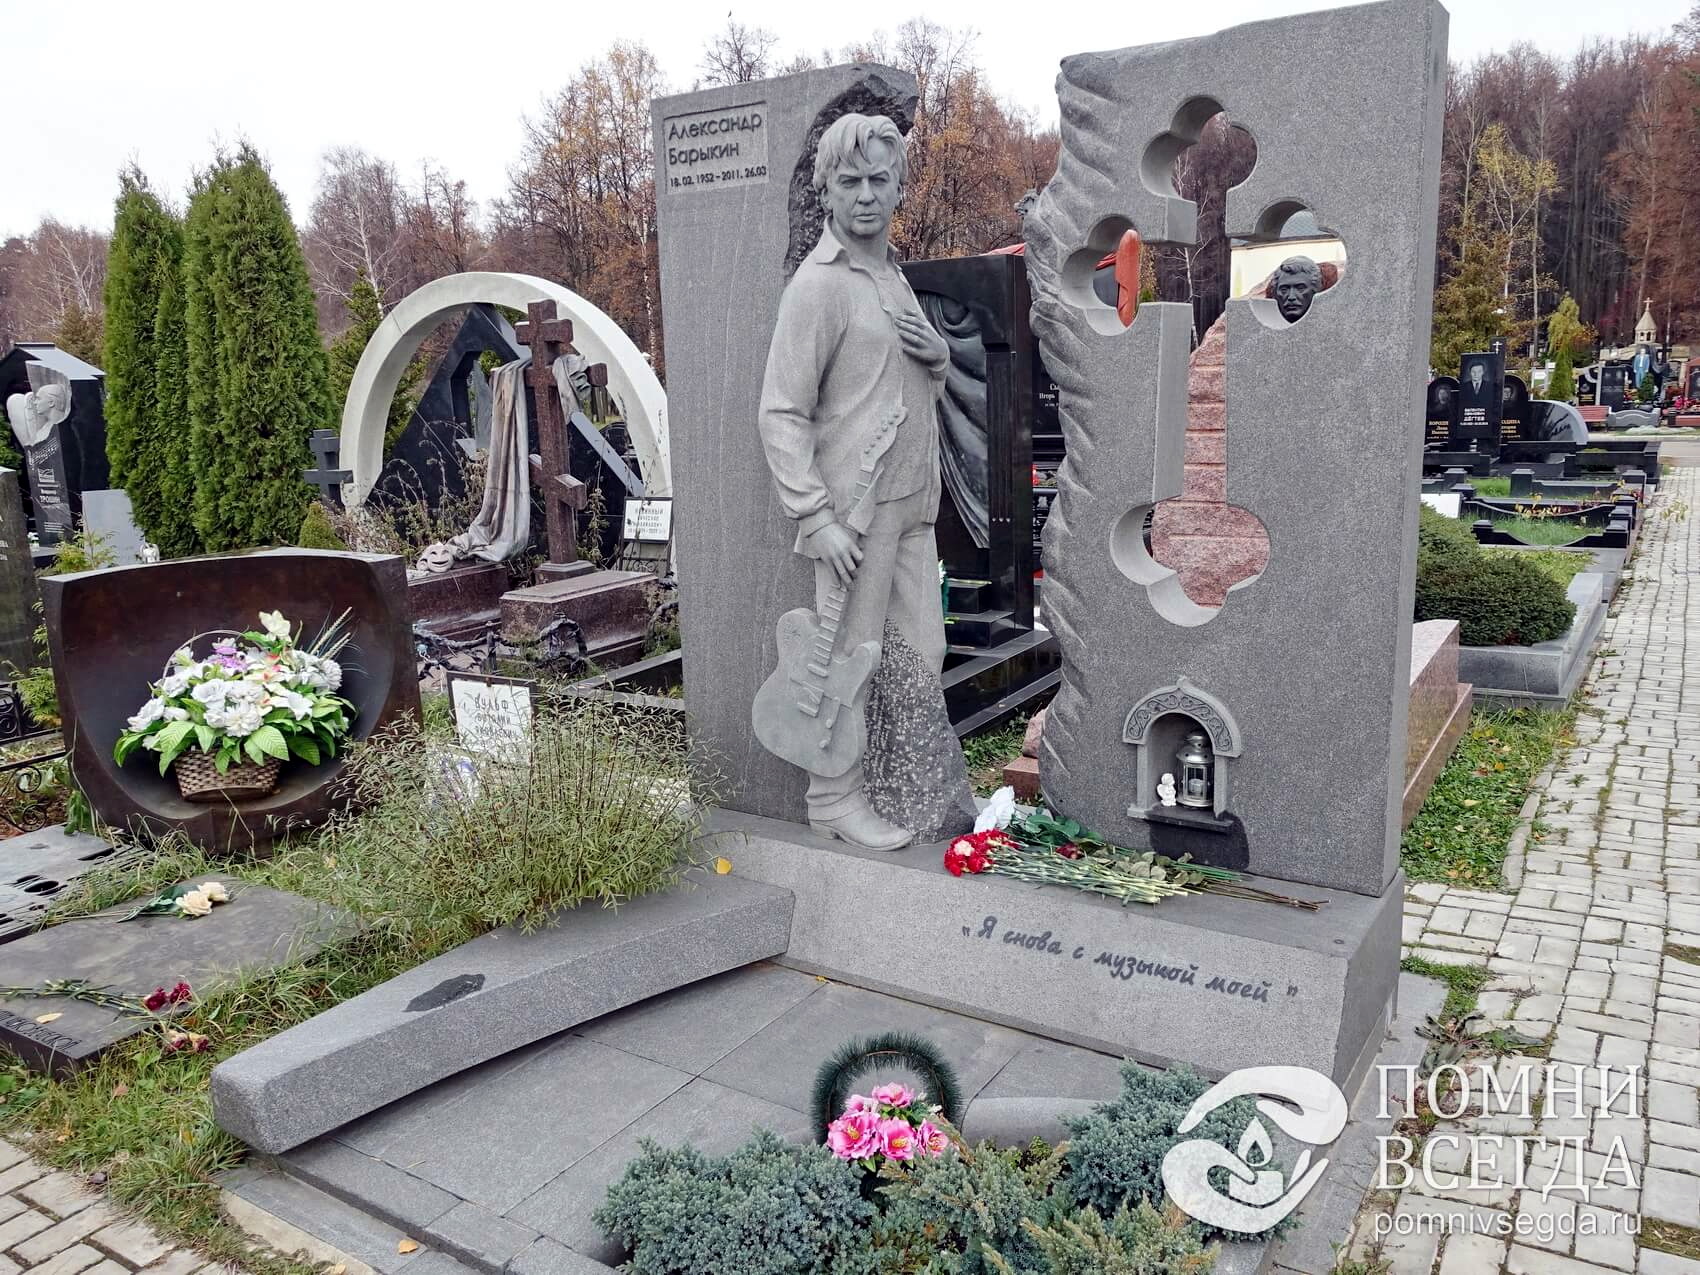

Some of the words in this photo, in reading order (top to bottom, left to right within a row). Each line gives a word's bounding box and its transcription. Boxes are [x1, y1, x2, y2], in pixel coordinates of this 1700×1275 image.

[668, 113, 762, 141] Александр
[668, 142, 740, 166] Барыкин
[1003, 930, 1062, 955] снова
[1072, 946, 1085, 959] с
[1094, 952, 1199, 985] музыкой
